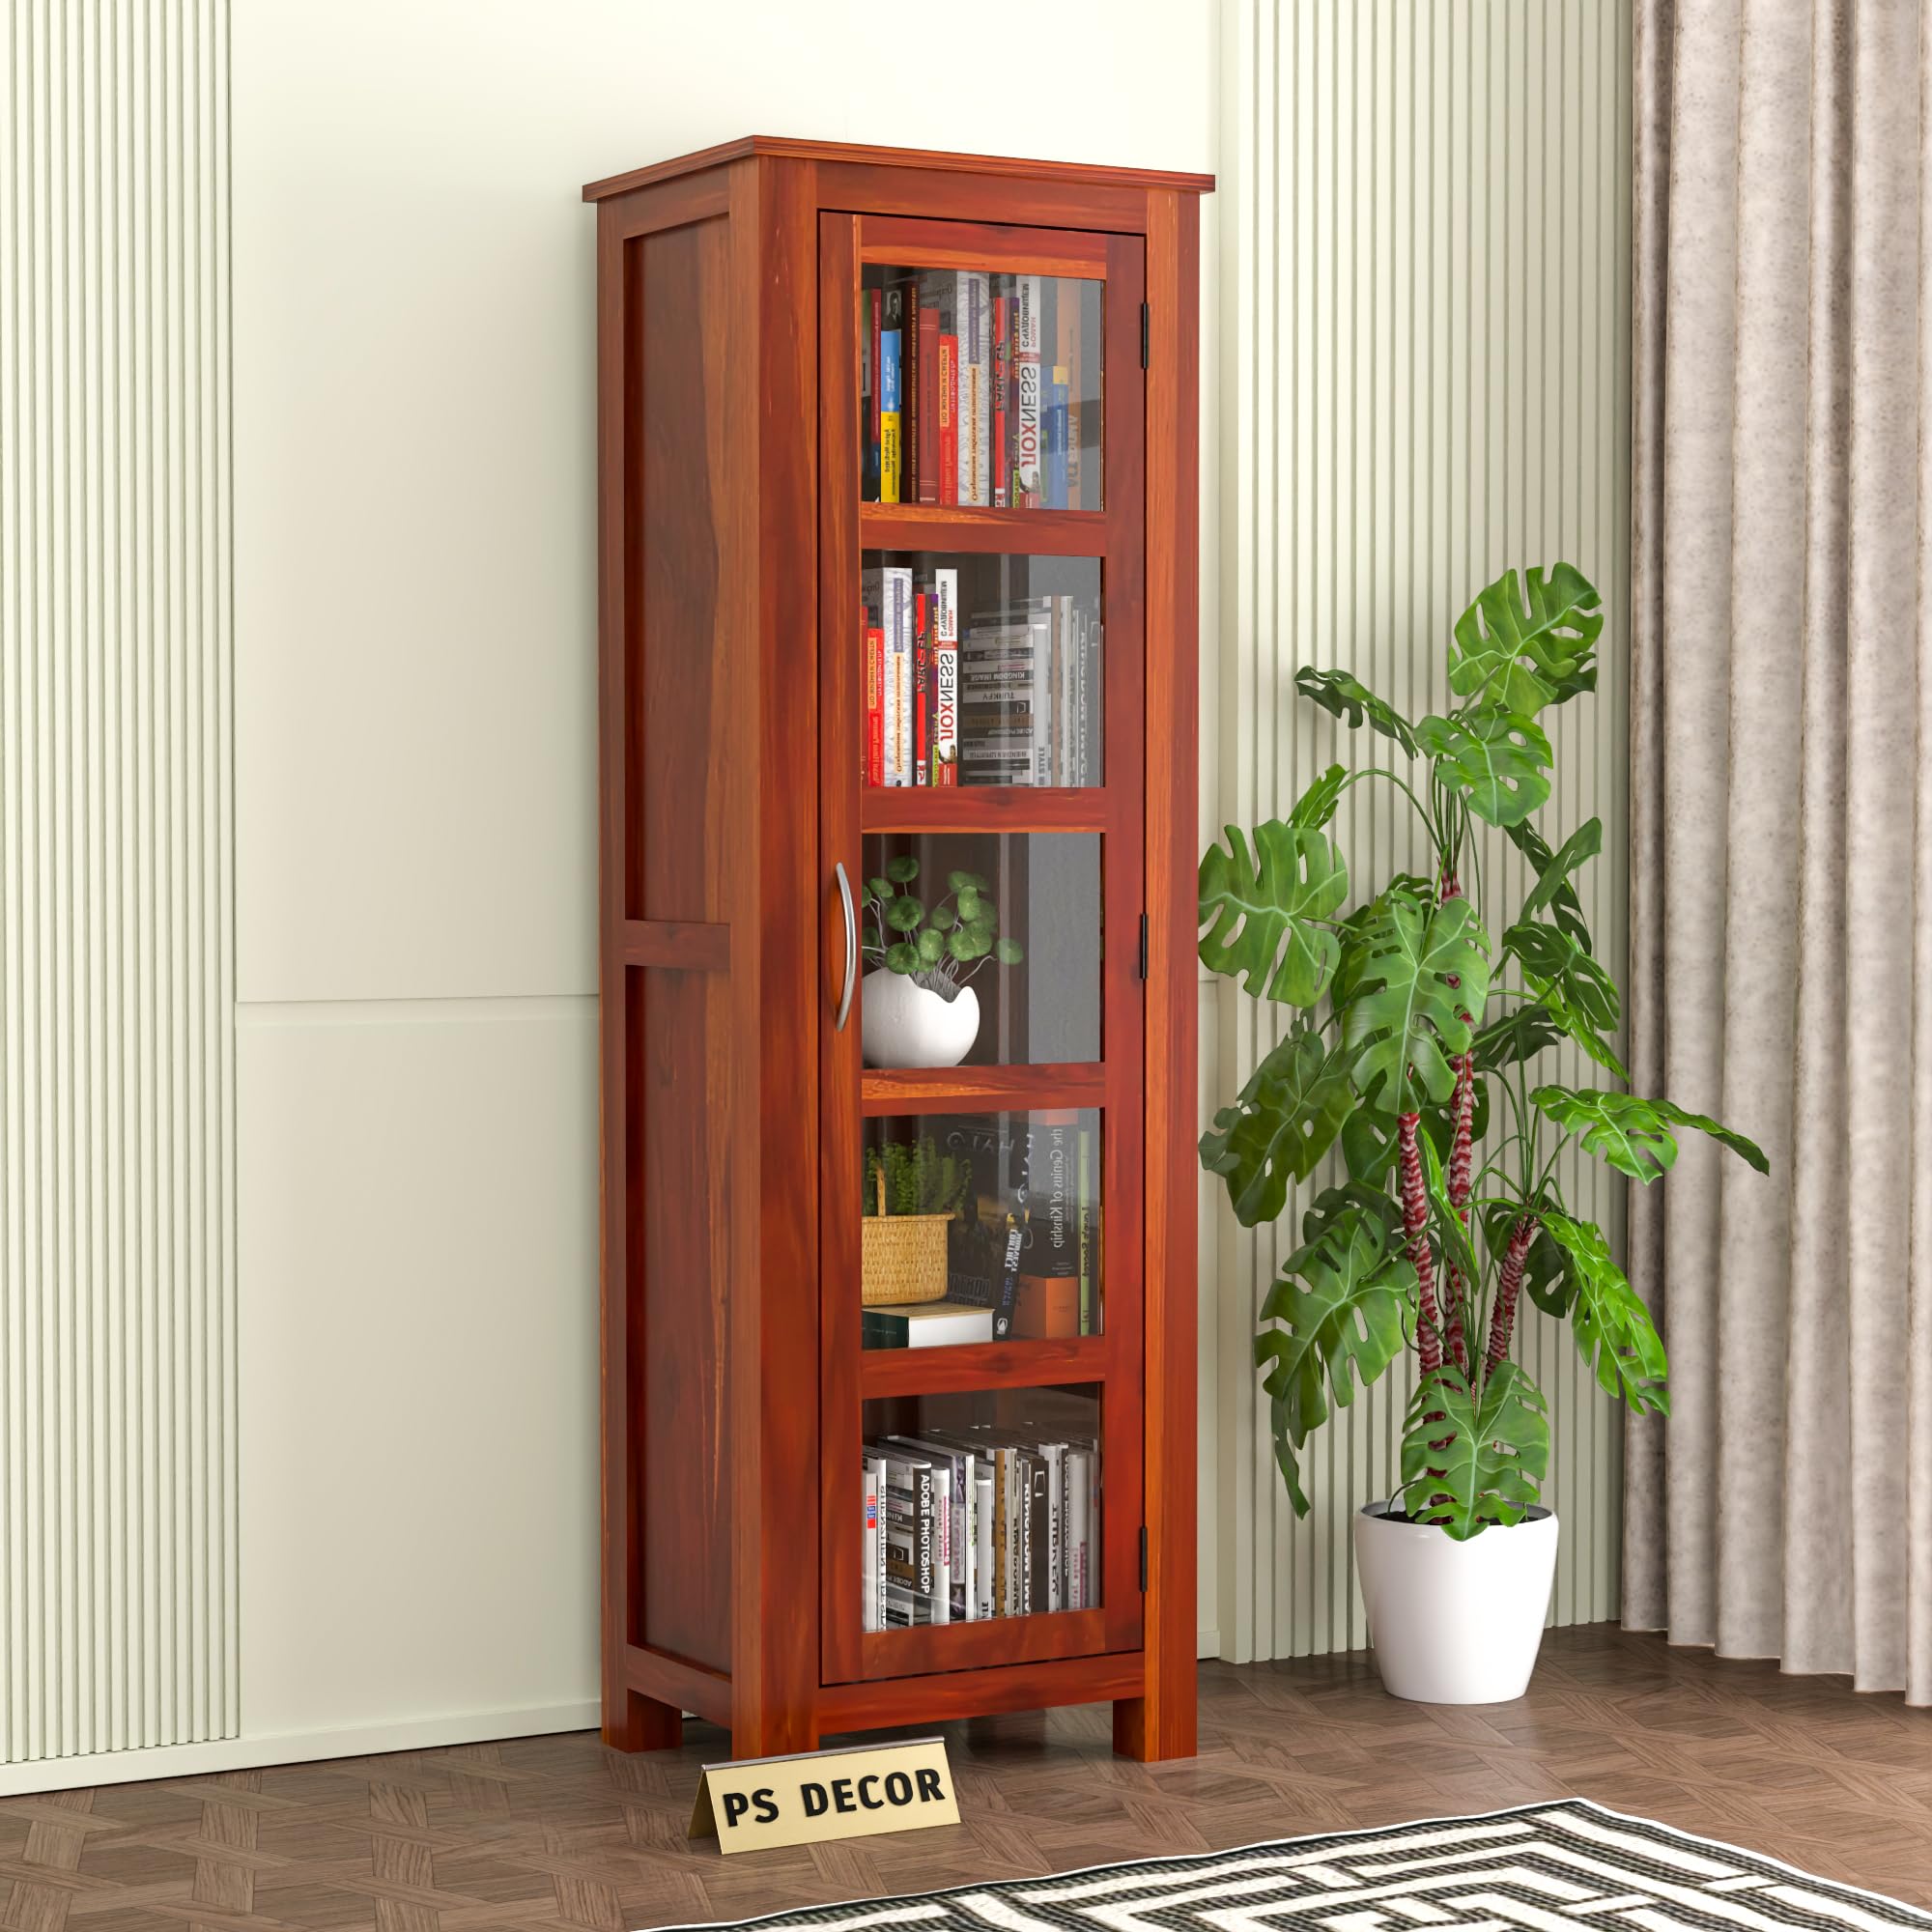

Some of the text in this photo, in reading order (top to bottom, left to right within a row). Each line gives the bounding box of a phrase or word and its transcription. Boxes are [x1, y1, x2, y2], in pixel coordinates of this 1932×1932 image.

[921, 1474, 930, 1594] ADOBE PHOTOSHOP
[723, 1768, 946, 1828] PS DECOR
